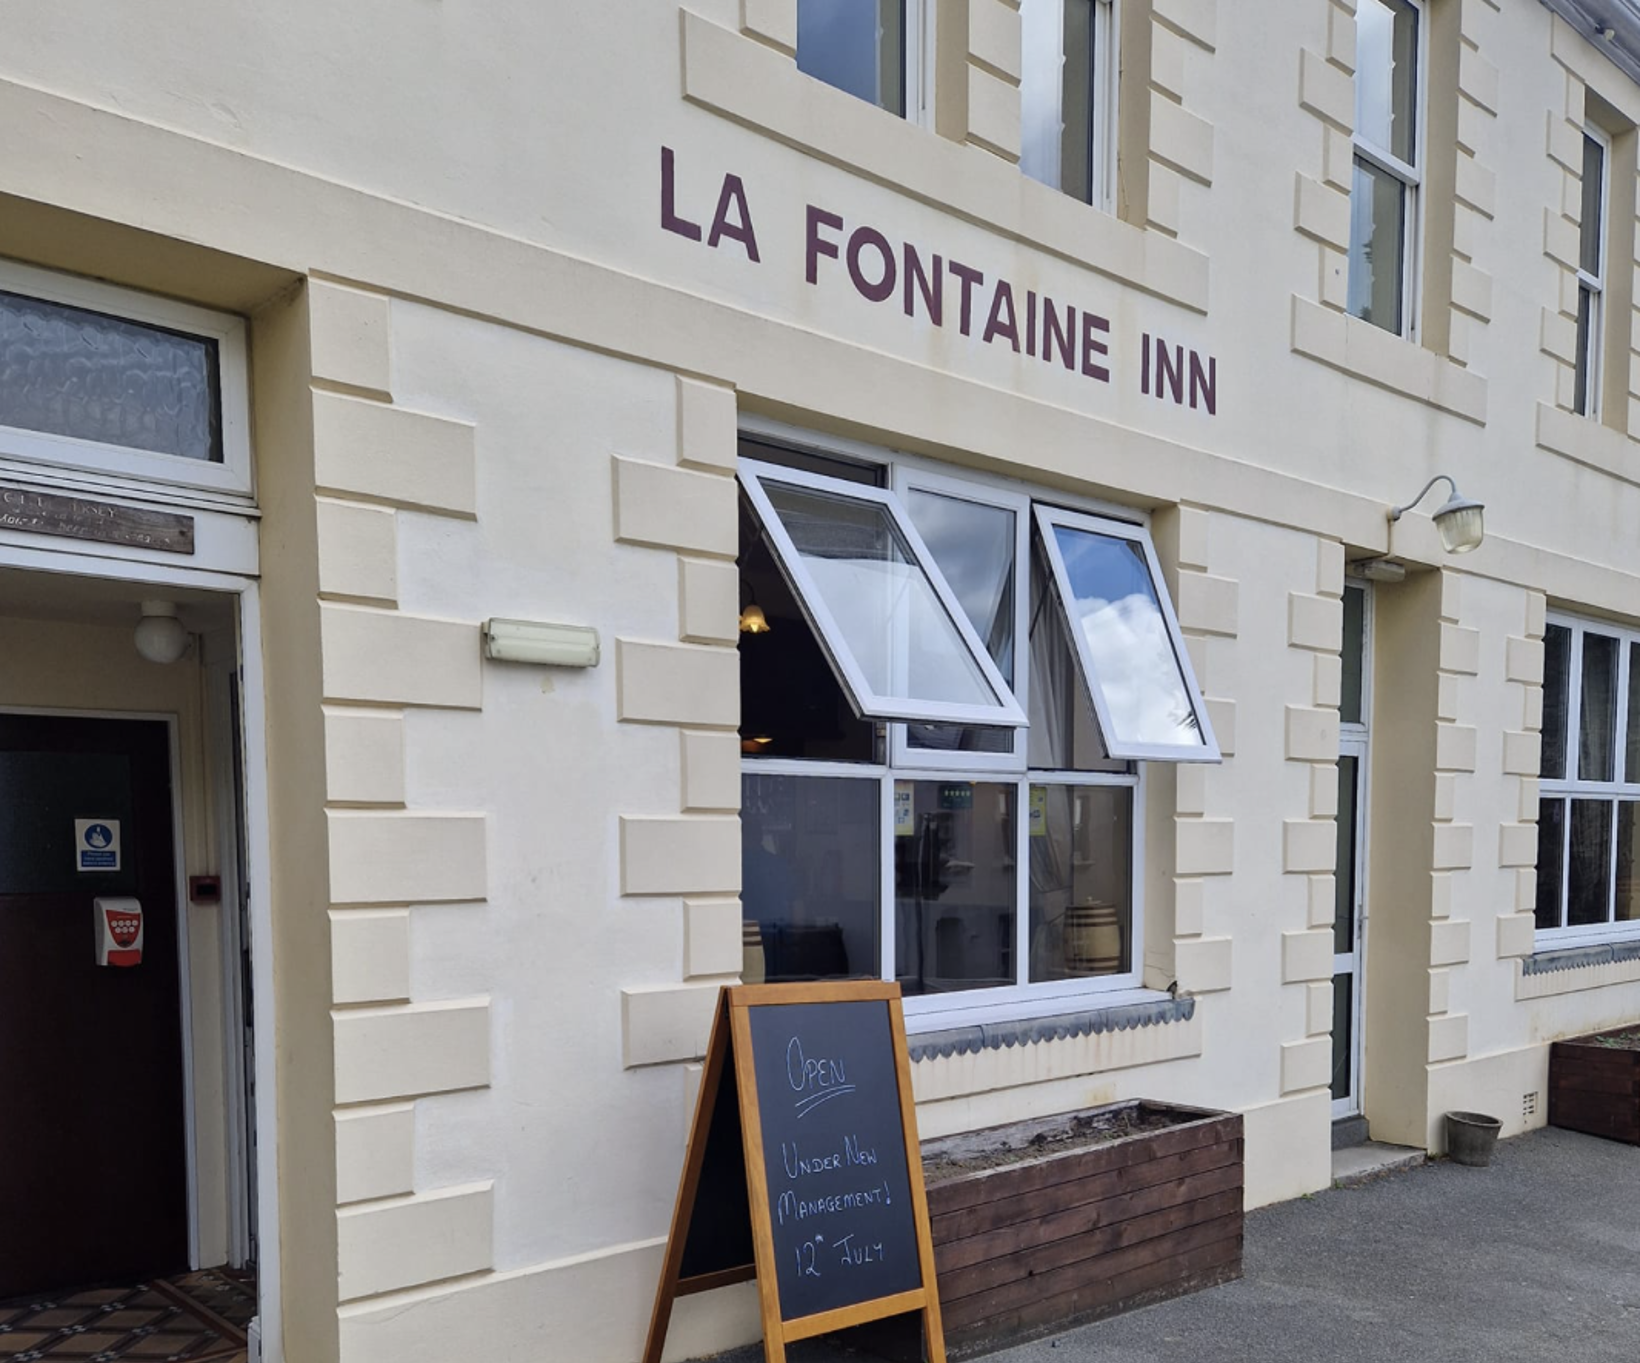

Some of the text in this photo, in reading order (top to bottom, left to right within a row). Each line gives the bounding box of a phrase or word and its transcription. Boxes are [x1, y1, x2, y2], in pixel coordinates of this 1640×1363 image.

[661, 146, 1216, 415] LA FONTAINE INN
[785, 1036, 846, 1092] OPEN
[781, 1134, 878, 1179] UNDER NEW
[777, 1181, 892, 1226] MANAGEMENT!
[832, 1233, 885, 1266] JULY
